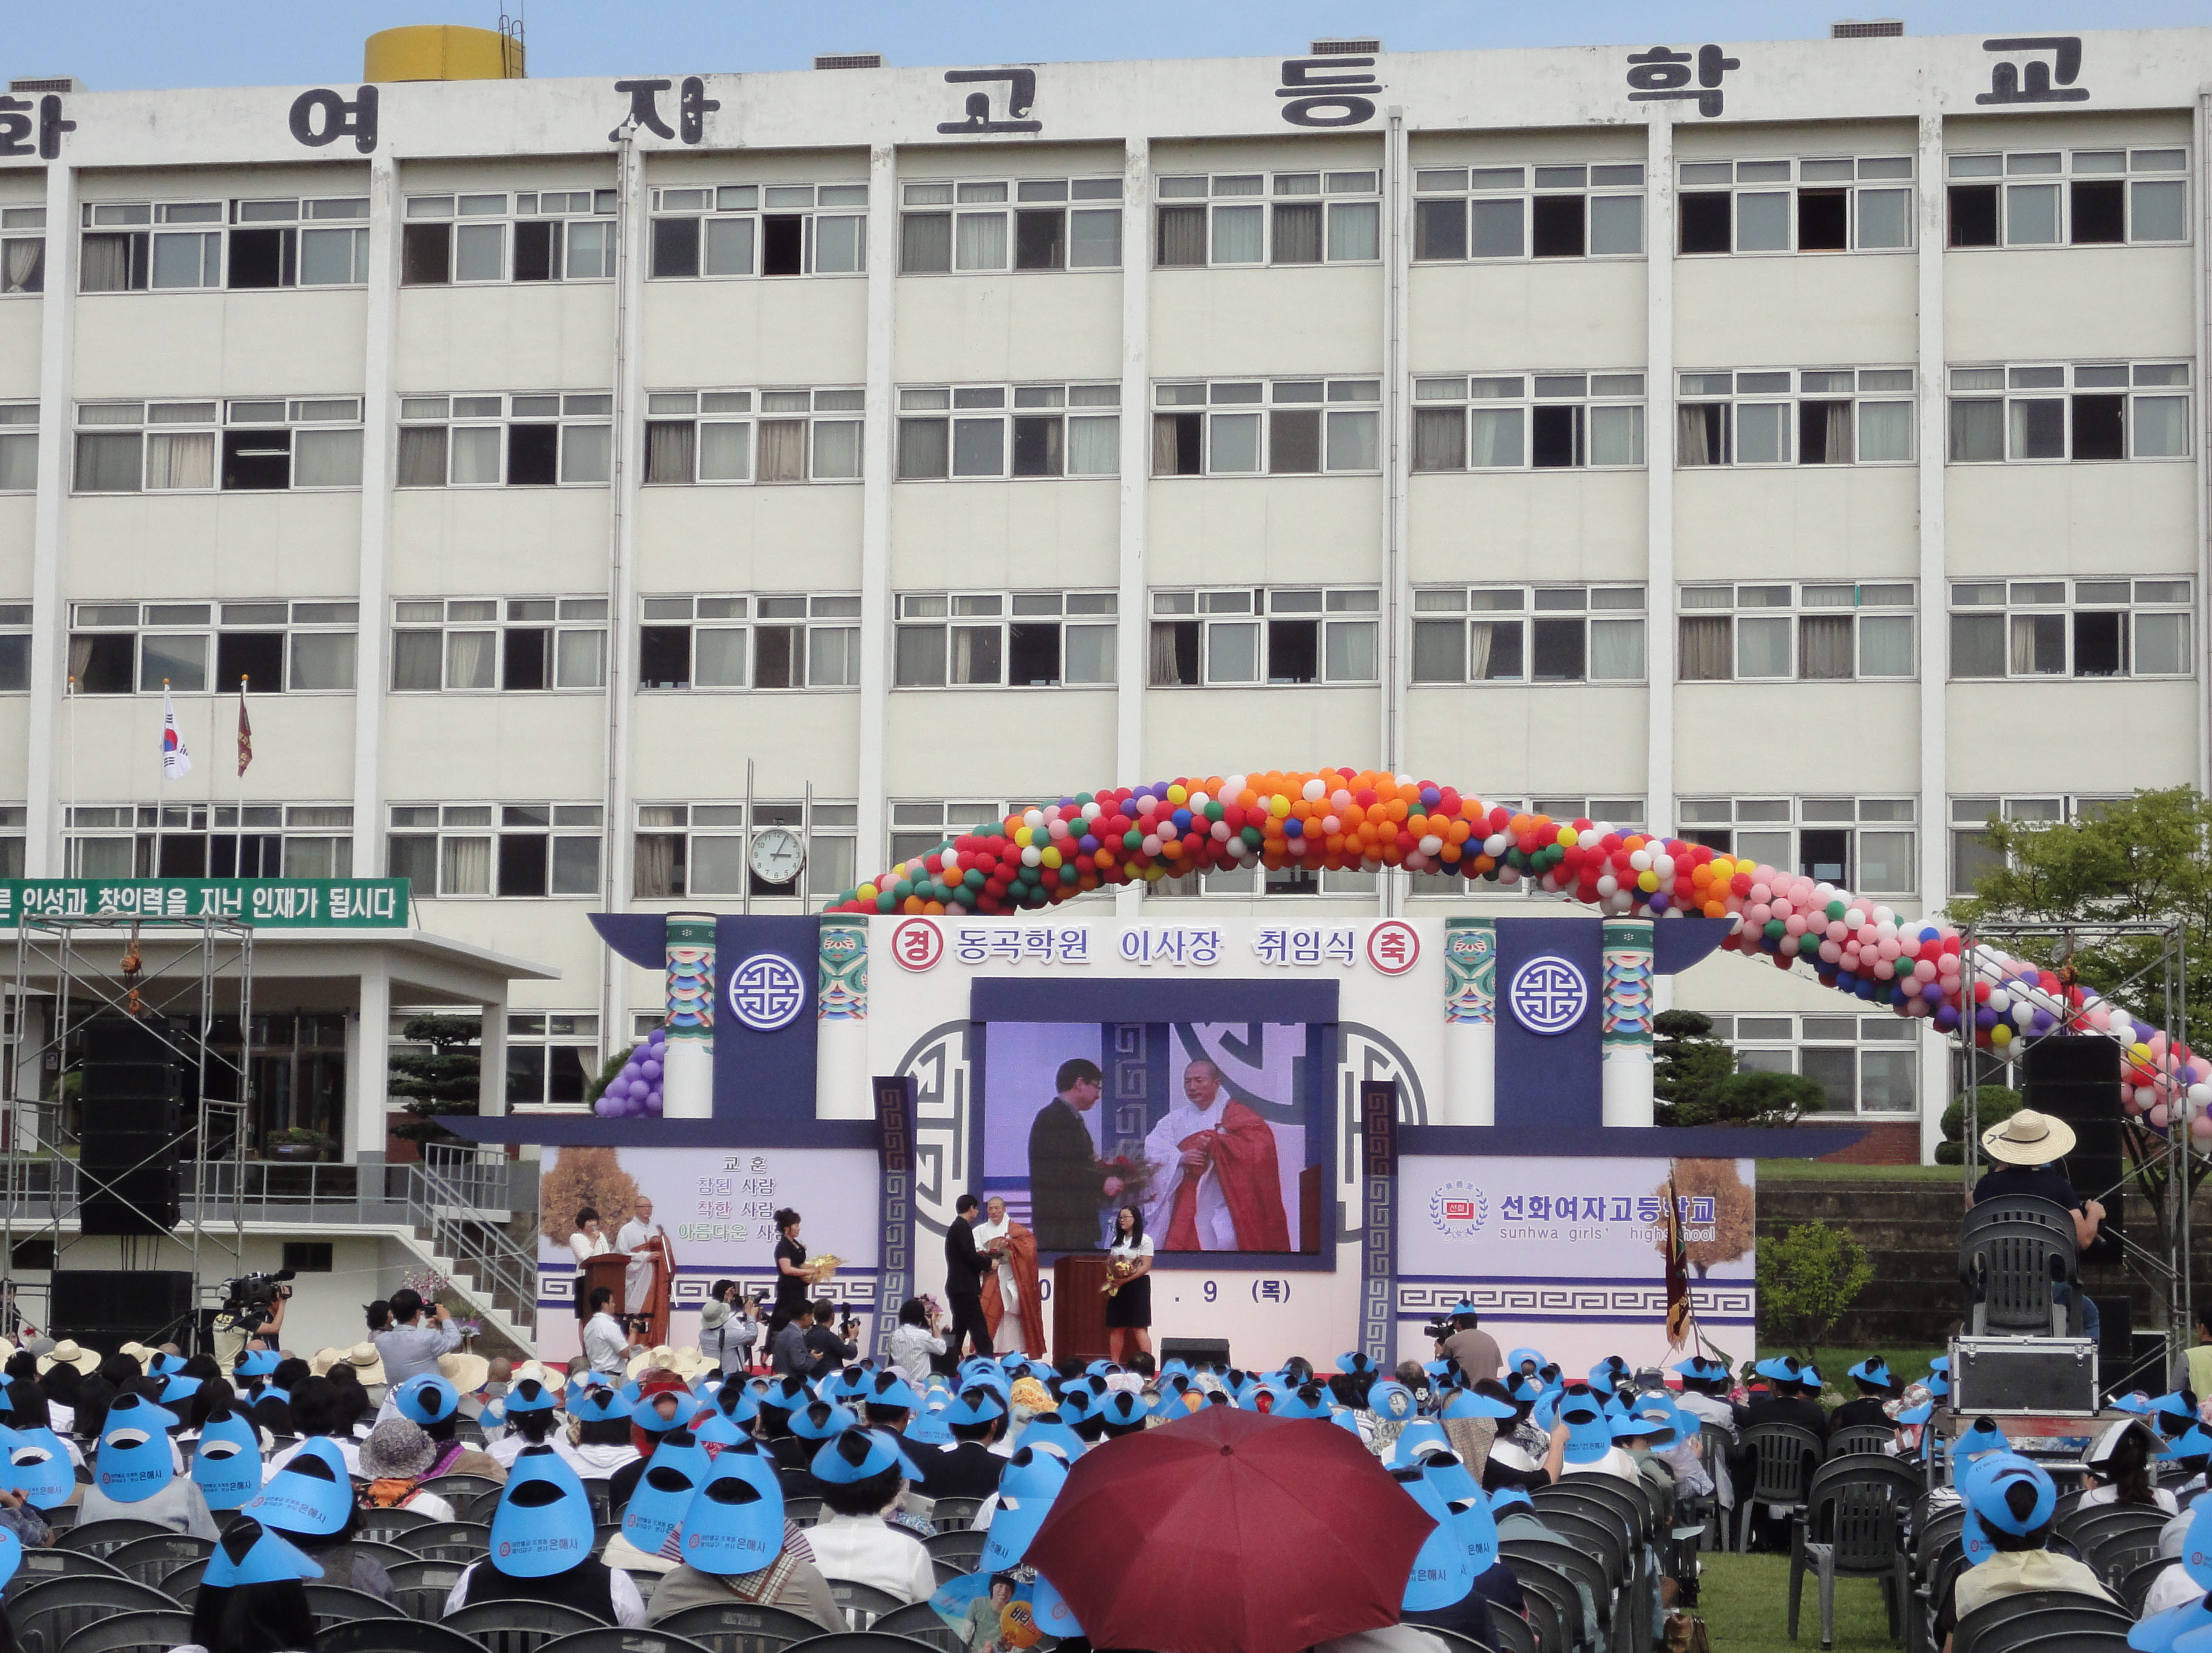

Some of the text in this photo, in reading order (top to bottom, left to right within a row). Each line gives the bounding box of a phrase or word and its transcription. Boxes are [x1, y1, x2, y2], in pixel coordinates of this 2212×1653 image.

[289, 85, 378, 153] 여
[609, 76, 720, 144] 자
[937, 69, 1043, 134] 고
[1275, 57, 1383, 126] 등
[1626, 44, 1740, 117] 학
[1975, 36, 2090, 104] 교
[22, 888, 87, 915] 인성과
[98, 888, 187, 915] 창이력을
[199, 888, 242, 915] 지닌
[253, 888, 318, 918] 인재가
[329, 888, 396, 918] 됩시다
[904, 929, 1406, 962] 경 동곡학원 이사장 취임식 축
[723, 1156, 766, 1172] 교 훈
[697, 1177, 775, 1195] 참된 사람
[697, 1201, 775, 1218] 착한 사람
[679, 1223, 747, 1240] 아름다운
[1500, 1227, 1559, 1240] sunhwa
[1630, 1227, 1715, 1243] highshool
[1252, 1280, 1291, 1303] (목)
[549, 1538, 578, 1550] 은해사
[736, 1538, 765, 1553] 은해사
[1468, 1542, 1490, 1555] 은해사
[1417, 1569, 1446, 1582] 은해사
